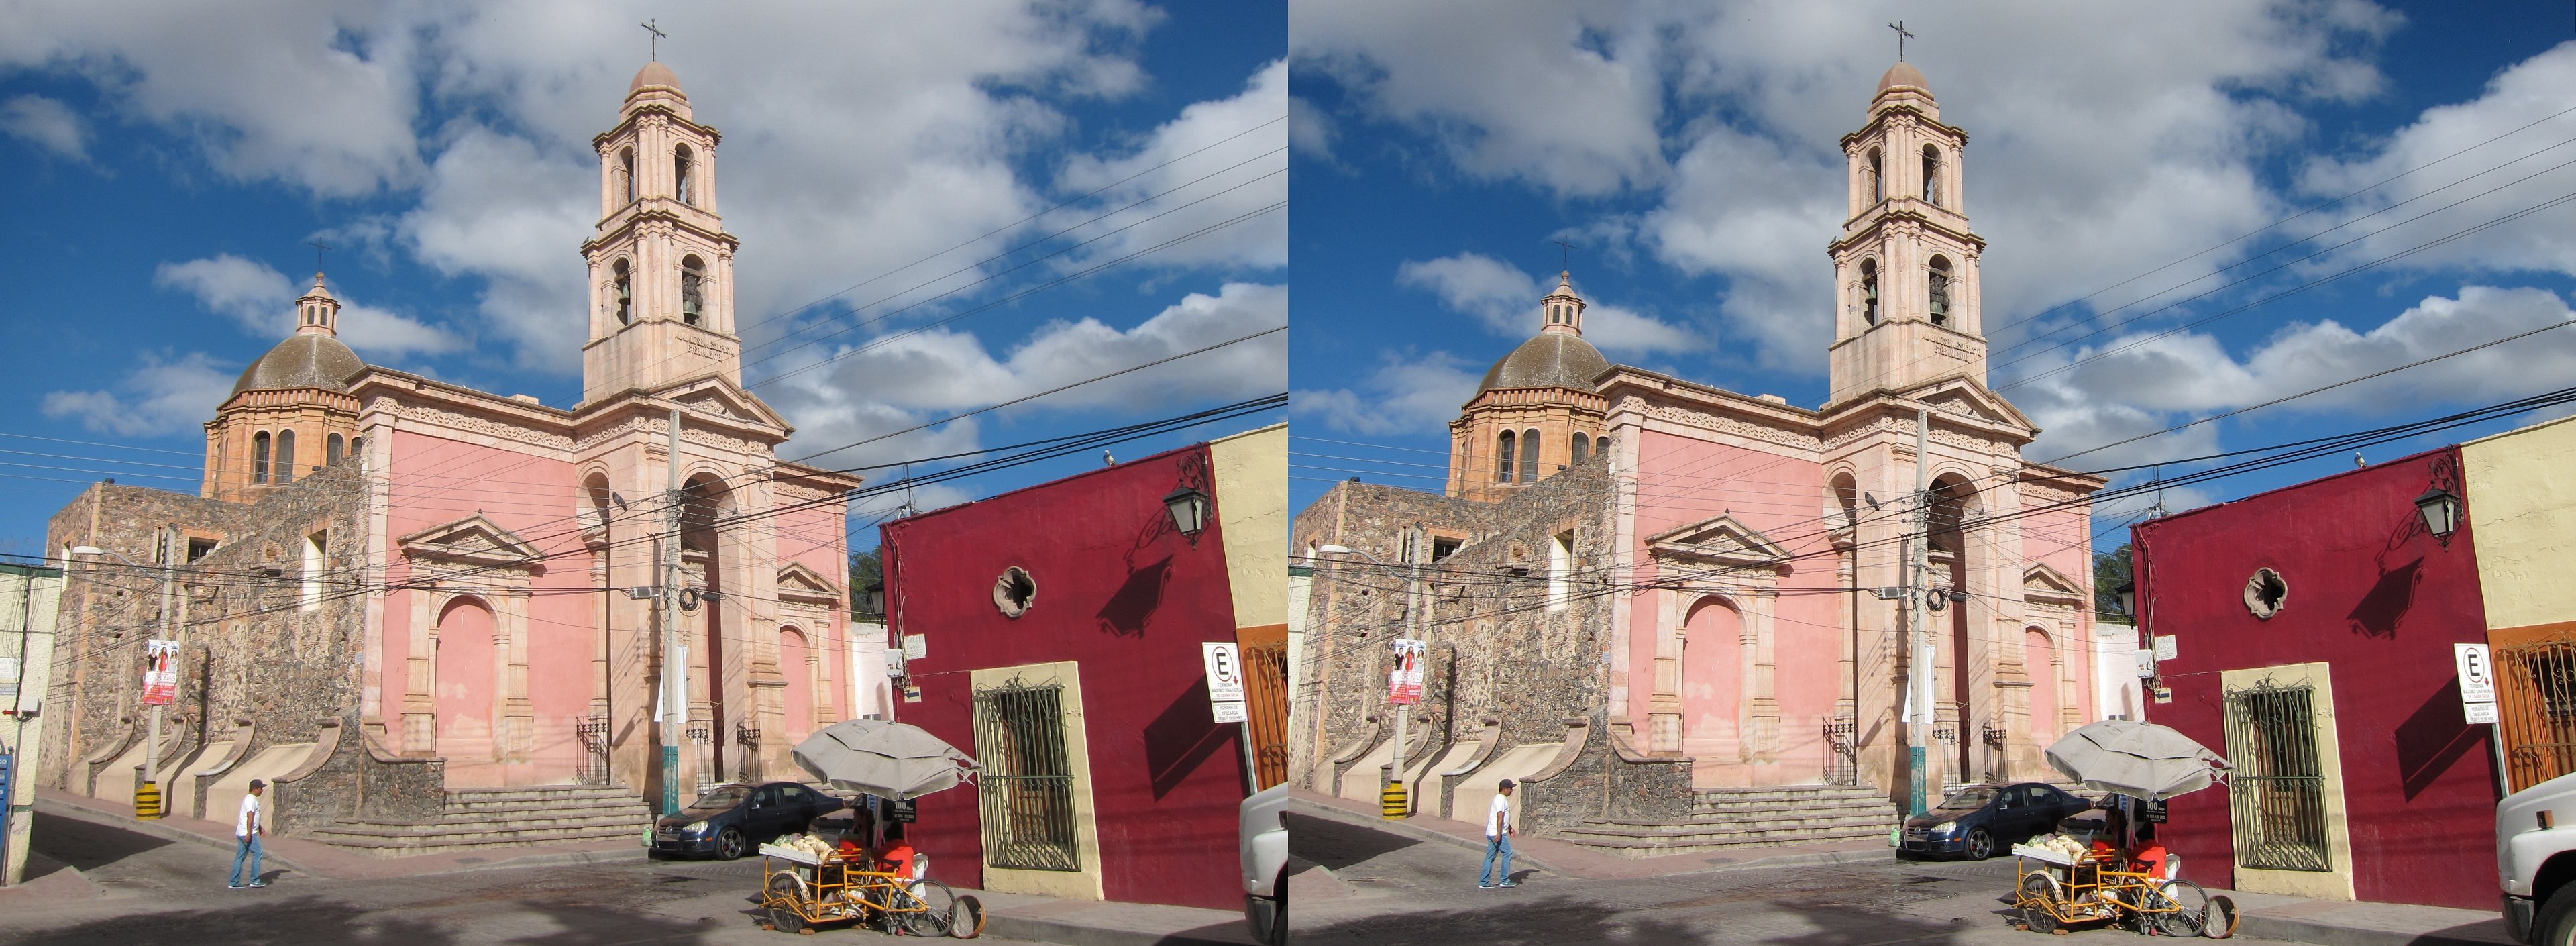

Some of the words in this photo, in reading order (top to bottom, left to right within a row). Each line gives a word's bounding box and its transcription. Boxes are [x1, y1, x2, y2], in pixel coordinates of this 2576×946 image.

[1216, 653, 1229, 675] E
[2468, 654, 2480, 676] E
[894, 802, 906, 810] 100
[2147, 802, 2158, 810] 100
